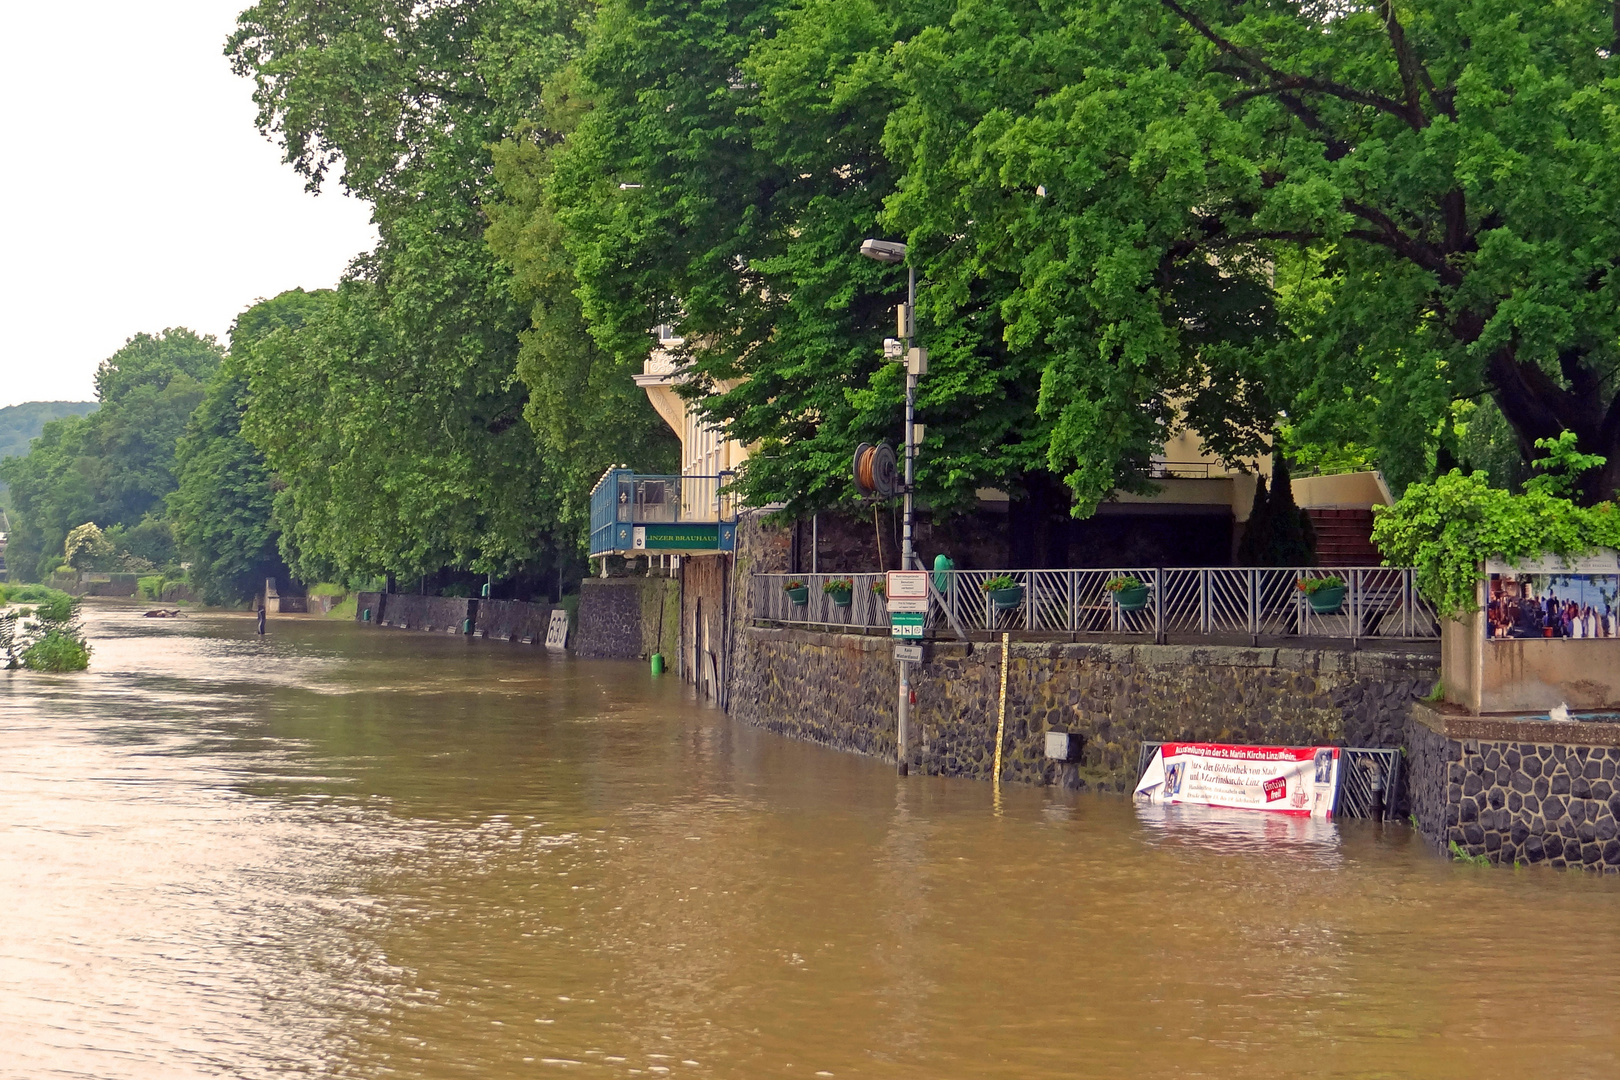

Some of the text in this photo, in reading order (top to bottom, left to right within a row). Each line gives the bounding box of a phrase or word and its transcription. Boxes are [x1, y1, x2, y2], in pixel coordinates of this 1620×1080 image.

[548, 617, 567, 644] 630
[1175, 746, 1205, 757] Ausstellung
[1205, 747, 1211, 756] in
[1212, 748, 1221, 756] der
[1221, 749, 1229, 757] St.
[1246, 751, 1266, 760] Kirche
[1214, 762, 1248, 775] Bibliothek
[1264, 779, 1286, 792] Eintritt
